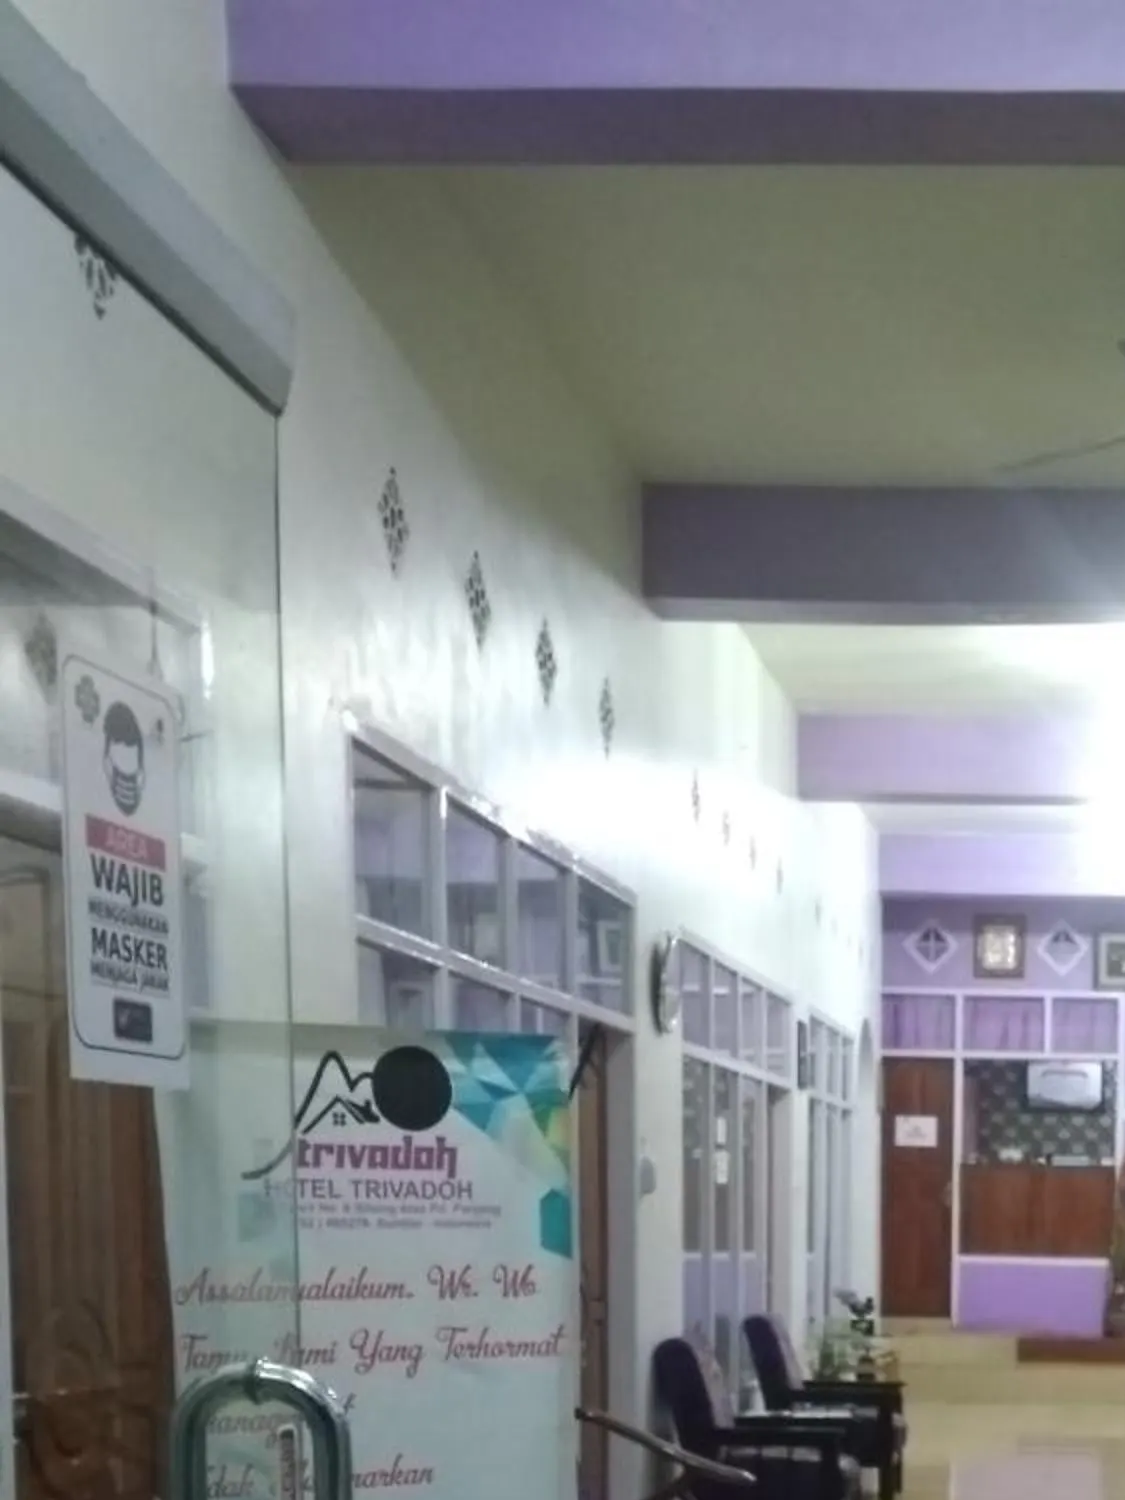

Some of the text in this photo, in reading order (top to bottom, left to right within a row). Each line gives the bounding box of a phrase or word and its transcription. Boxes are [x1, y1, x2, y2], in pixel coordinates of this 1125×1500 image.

[105, 826, 148, 861] AREA
[91, 853, 164, 907] WAJIB
[91, 927, 168, 972] MASKER
[352, 1180, 474, 1201] TRIVADOH
[427, 1264, 479, 1300] Wr.
[349, 1328, 423, 1379] Yang
[435, 1324, 567, 1362] Terhormat
